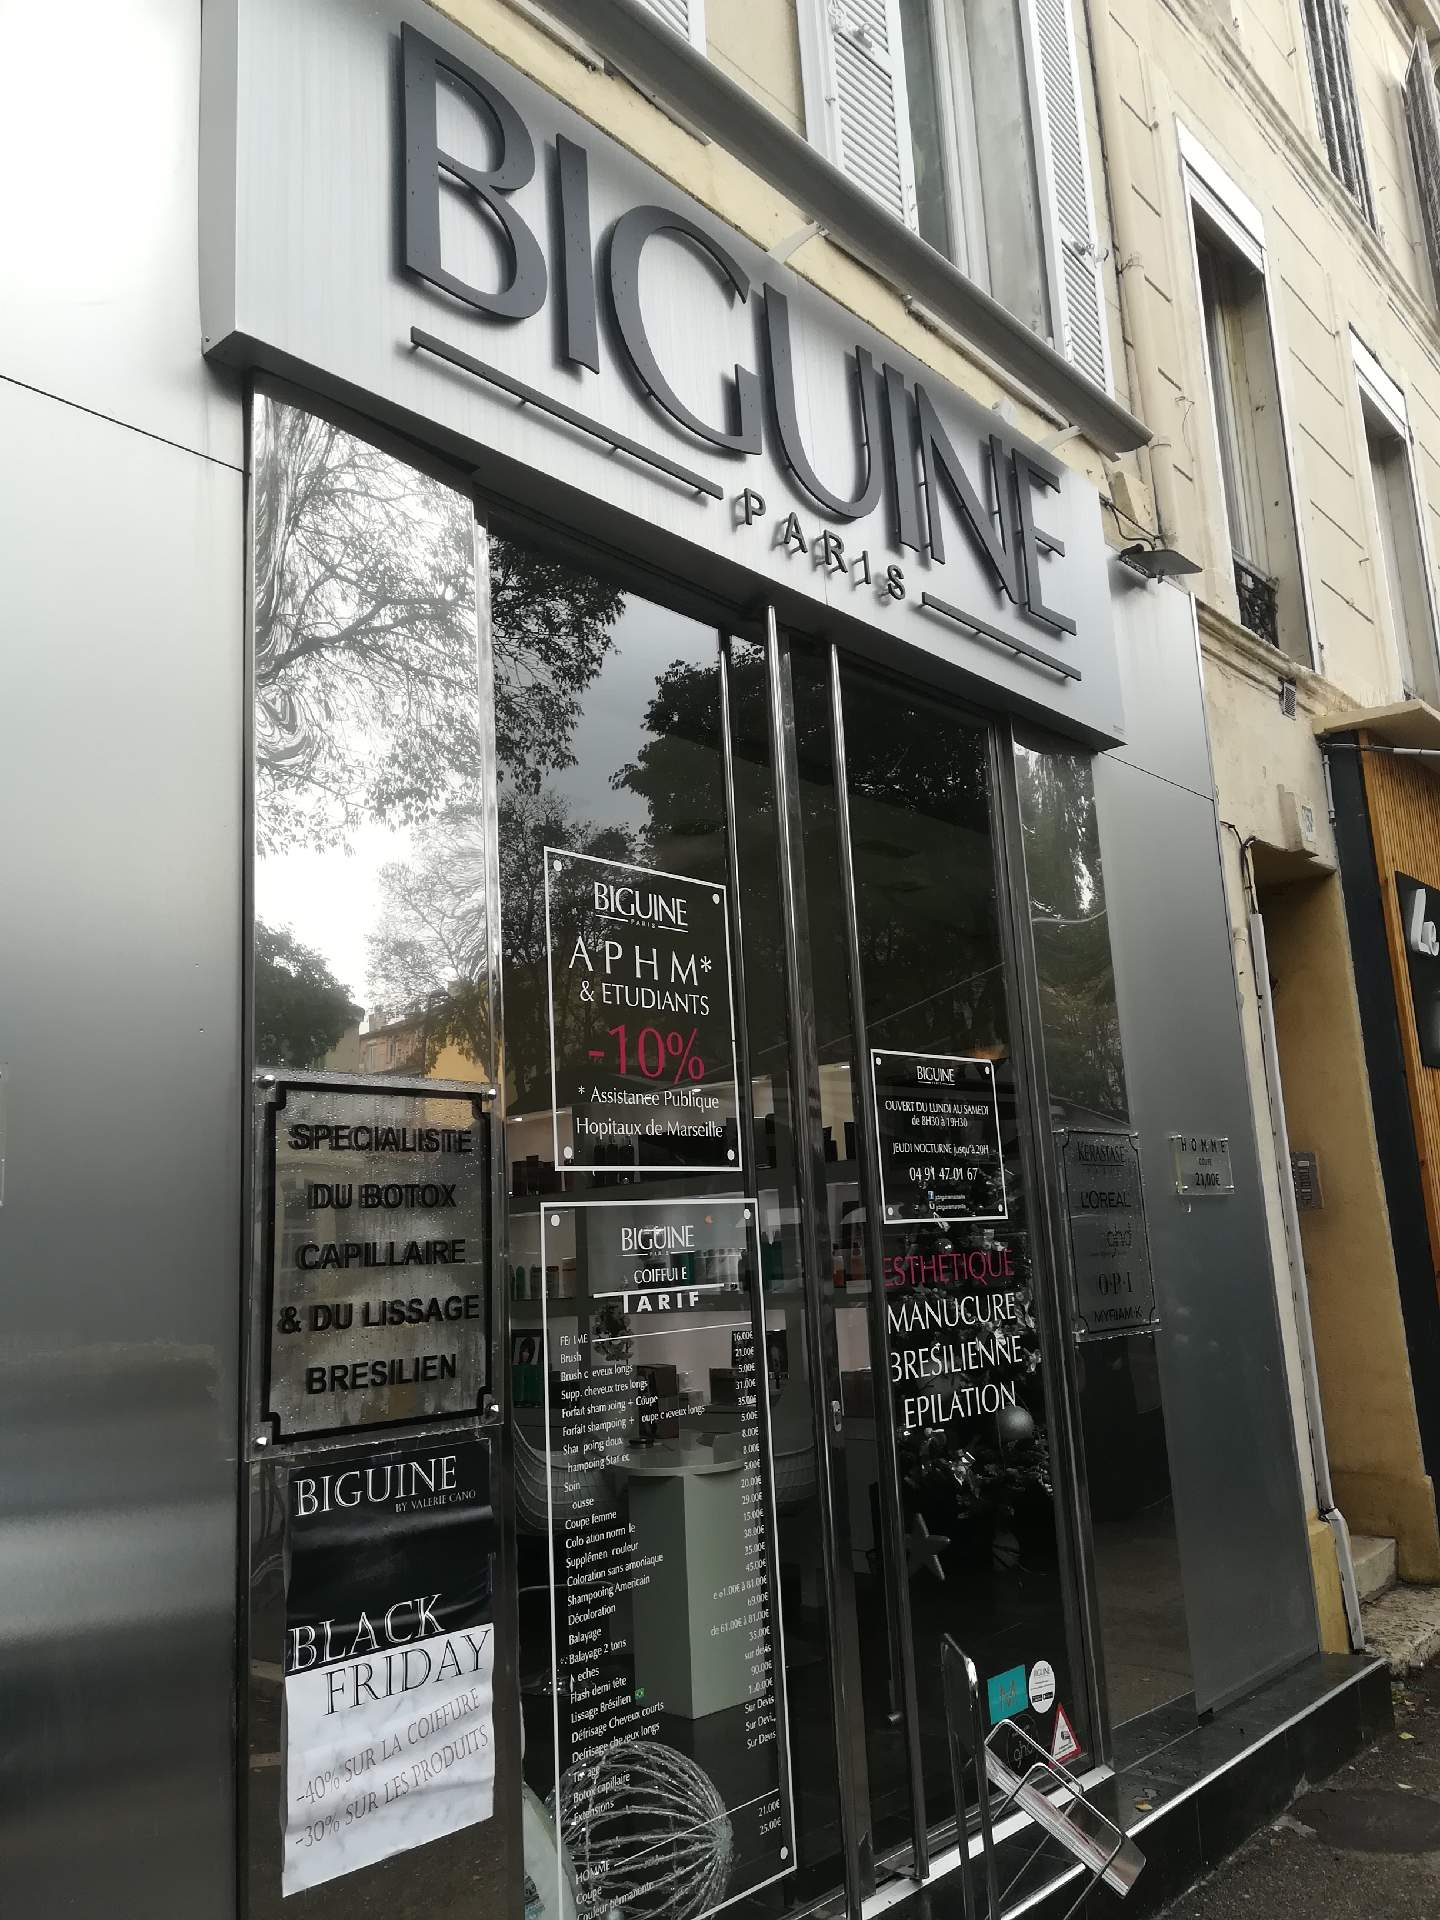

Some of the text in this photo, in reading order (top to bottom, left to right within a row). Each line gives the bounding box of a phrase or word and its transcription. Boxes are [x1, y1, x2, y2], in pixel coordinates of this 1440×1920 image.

[400, 21, 1077, 635] BIGUINE
[744, 489, 906, 601] PARIS
[594, 881, 688, 926] BIGUINE
[580, 980, 709, 1016] & ETUDIANTS
[588, 1024, 704, 1084] -10%
[917, 1066, 955, 1082] BIGUINE
[591, 1086, 719, 1113] Assistance Publique
[885, 1101, 988, 1115] OUVERT DU LUNDI AU SAMEDI
[576, 1117, 722, 1139] Hopitaux de Marseille
[912, 1116, 920, 1125] de
[288, 1124, 472, 1152] SPECIALISTE
[893, 1142, 912, 1154] JEUDI
[914, 1144, 952, 1154] NOCTURNE
[909, 1167, 922, 1181] 04
[924, 1167, 936, 1180] 91
[953, 1168, 963, 1180] 01
[967, 1168, 978, 1180] 67
[308, 1184, 456, 1210] DU BOTOX
[621, 1225, 695, 1251] BIGUINE
[296, 1239, 466, 1271] CAPILLAIRE
[882, 1249, 1015, 1287] ESTHETIQUE
[276, 1295, 480, 1334] & DU LISSAGE
[622, 1291, 700, 1314] TARIF
[887, 1292, 1017, 1334] MANUCURE
[560, 1352, 581, 1364] Brush
[890, 1335, 1023, 1382] BRESILIENNE
[306, 1354, 457, 1395] BRESILIEN
[560, 1364, 633, 1382] Brush ceveux longs
[585, 1385, 613, 1397] cheveux
[630, 1380, 648, 1391] longs
[904, 1381, 1016, 1429] EPILATION
[563, 1425, 586, 1436] Forfait
[588, 1418, 626, 1433] shampoing
[642, 1413, 659, 1424] oupe
[688, 1404, 705, 1416] longs
[568, 1457, 605, 1473] hampoing
[294, 1455, 458, 1517] BIGUINE
[564, 1481, 581, 1492] Soin
[395, 1489, 477, 1513] BY VALERIE CANO
[572, 1498, 594, 1509] ousse
[565, 1512, 617, 1530] Coupe femme
[566, 1523, 635, 1549] Coloation normle
[566, 1551, 608, 1569] Supplémen
[567, 1555, 663, 1587] Coloration sans amoniaque
[568, 1586, 614, 1606] Shampooing
[568, 1605, 616, 1626] Décoloration
[289, 1593, 446, 1672] BLACK
[569, 1628, 602, 1645] Balayage
[569, 1640, 627, 1664] Balayage 2 tons
[322, 1628, 492, 1717] FRIDAY
[571, 1688, 589, 1704] Flash
[592, 1681, 611, 1696] demi
[571, 1695, 631, 1723] Lissage Brésilien
[571, 1702, 664, 1743] Défrisage Cheveux courts
[641, 1722, 660, 1736] longs
[296, 1687, 480, 1804] -40% SUR LA COIFFURE
[295, 1723, 489, 1849] -30% SUR LES PRODUITS
[576, 1886, 602, 1905] Coupe
